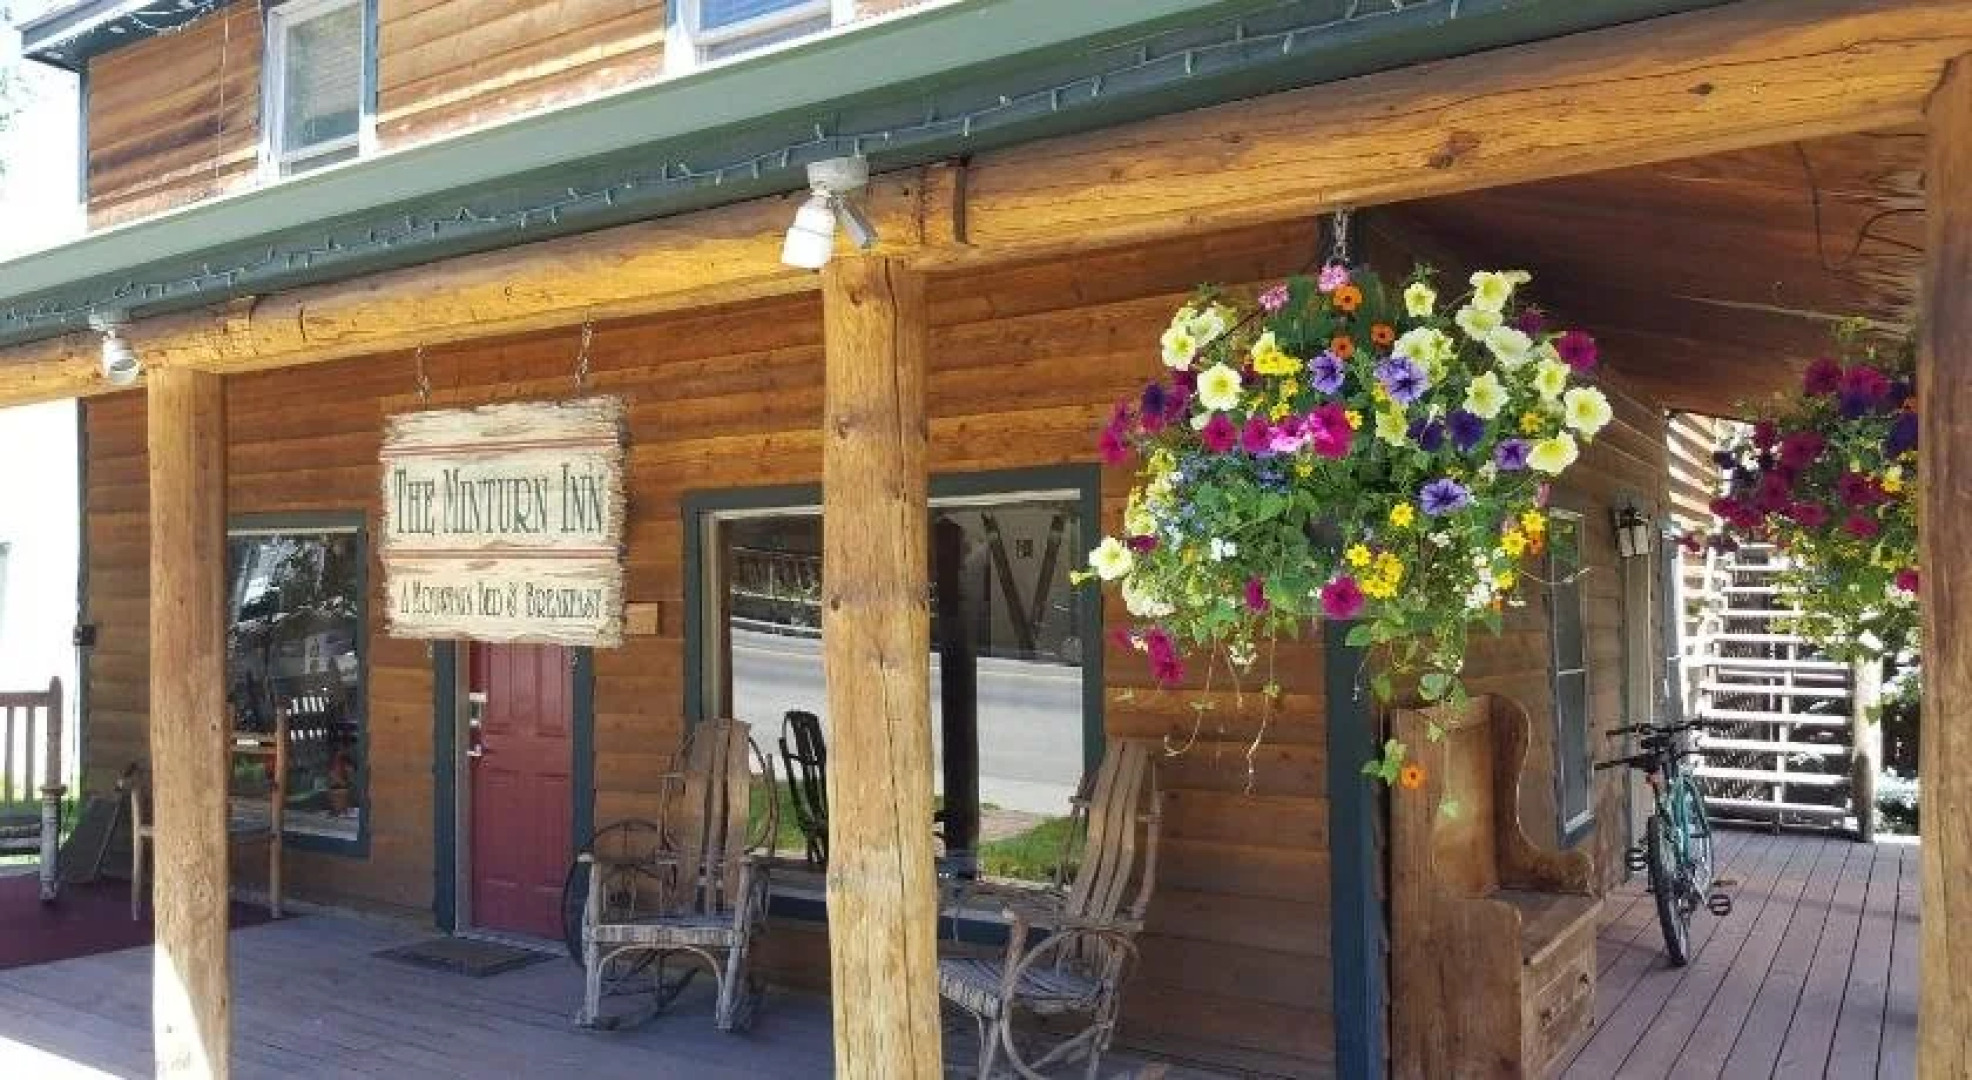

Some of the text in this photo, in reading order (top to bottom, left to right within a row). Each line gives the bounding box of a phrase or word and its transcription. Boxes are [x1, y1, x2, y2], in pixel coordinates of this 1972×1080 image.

[394, 463, 603, 534] THE MINTURN INN
[401, 581, 409, 613] A
[478, 581, 502, 615] BED
[507, 582, 517, 618] &
[526, 582, 601, 618] BREAKFAST
